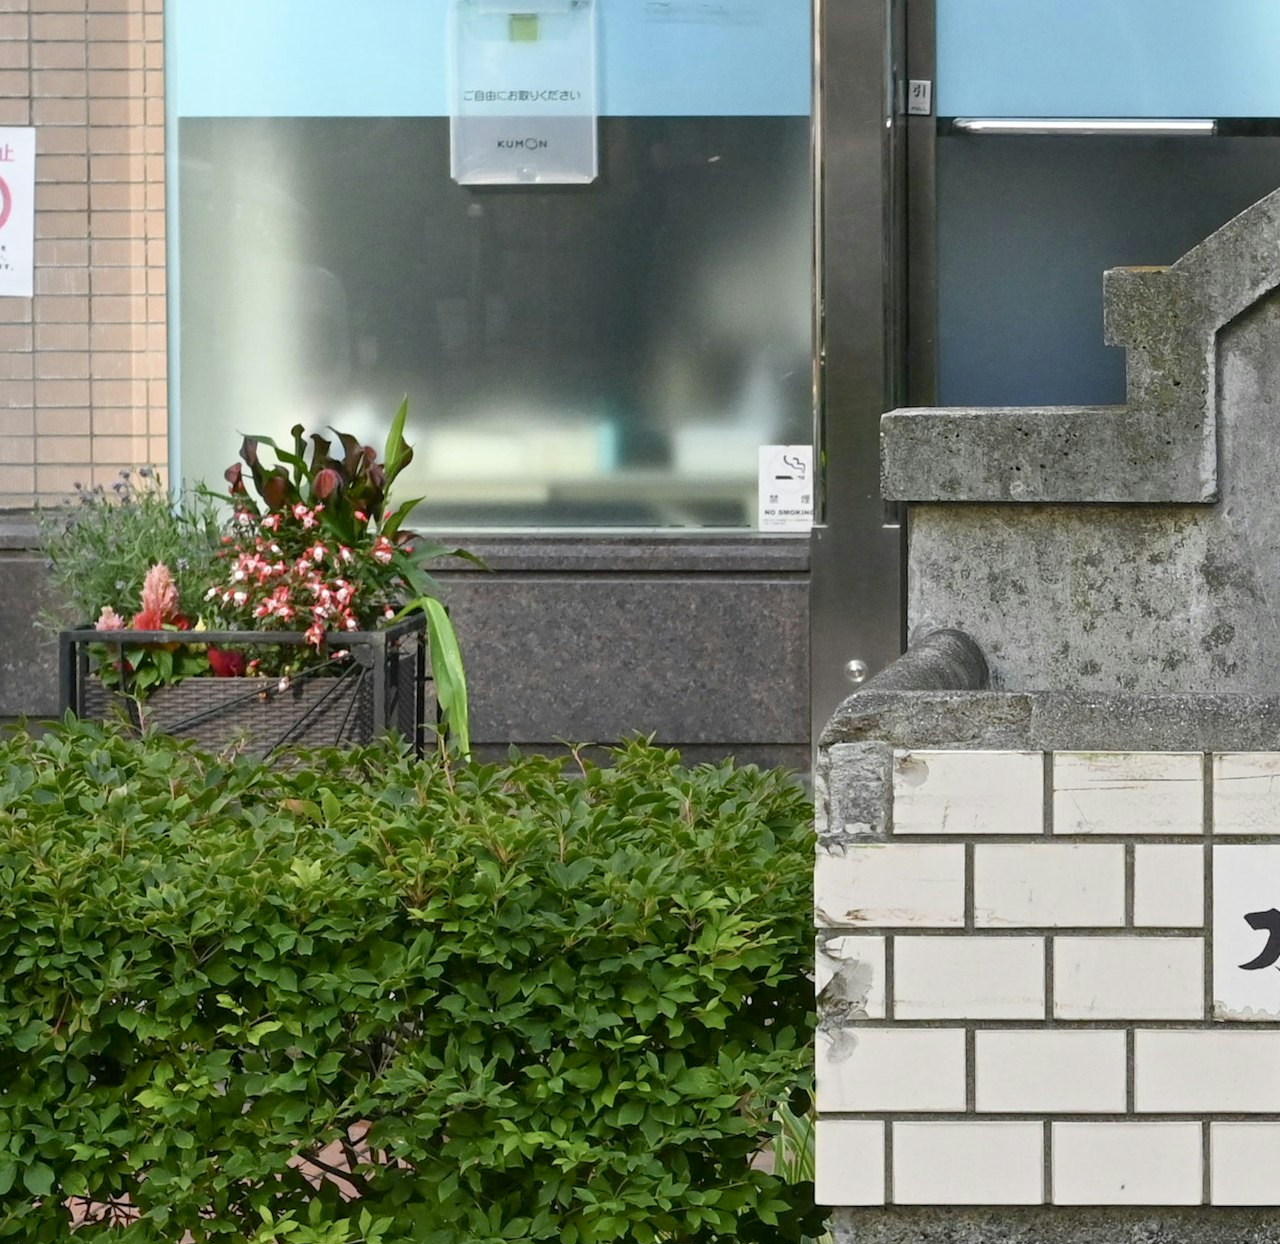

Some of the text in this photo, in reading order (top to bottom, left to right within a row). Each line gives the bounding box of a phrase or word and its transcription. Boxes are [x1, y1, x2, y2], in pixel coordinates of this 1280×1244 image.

[463, 90, 581, 102] ご自由にお取りください
[497, 138, 548, 150] KUMON
